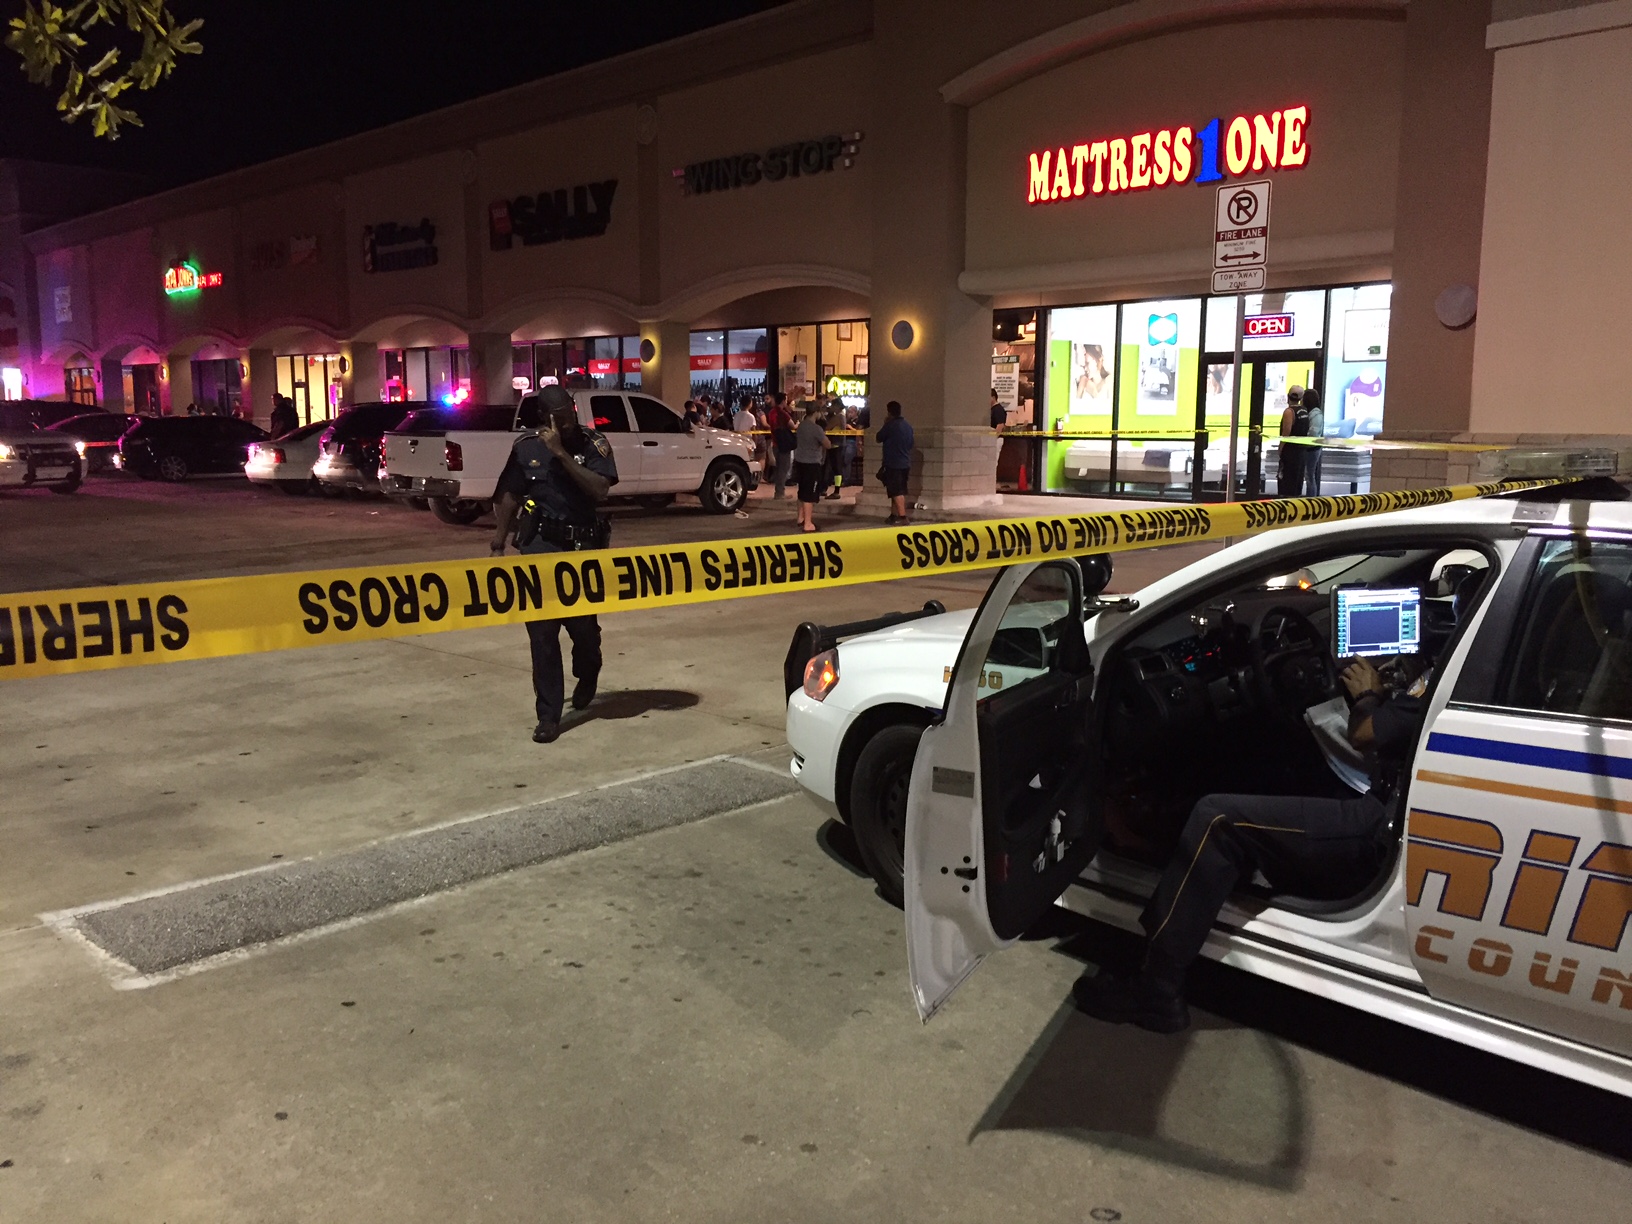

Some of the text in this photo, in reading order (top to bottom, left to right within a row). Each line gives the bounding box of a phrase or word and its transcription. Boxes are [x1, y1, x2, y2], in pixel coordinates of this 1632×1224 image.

[685, 135, 843, 194] WING STOP
[1028, 105, 1306, 203] MATTRESS 1 ONE
[511, 180, 617, 237] SALLY
[1219, 228, 1262, 241] FIRE LANE
[1229, 281, 1248, 289] ZONE
[1248, 318, 1286, 334] OPEN
[827, 377, 866, 397] OPEN
[1240, 487, 1453, 529] SHERIFFS LINE DO NOT CROSS
[896, 507, 1211, 570] SHERIFFS LINE DO NOT CROSS
[298, 539, 844, 635] SHERIFFS LINE DO NOT CROSS
